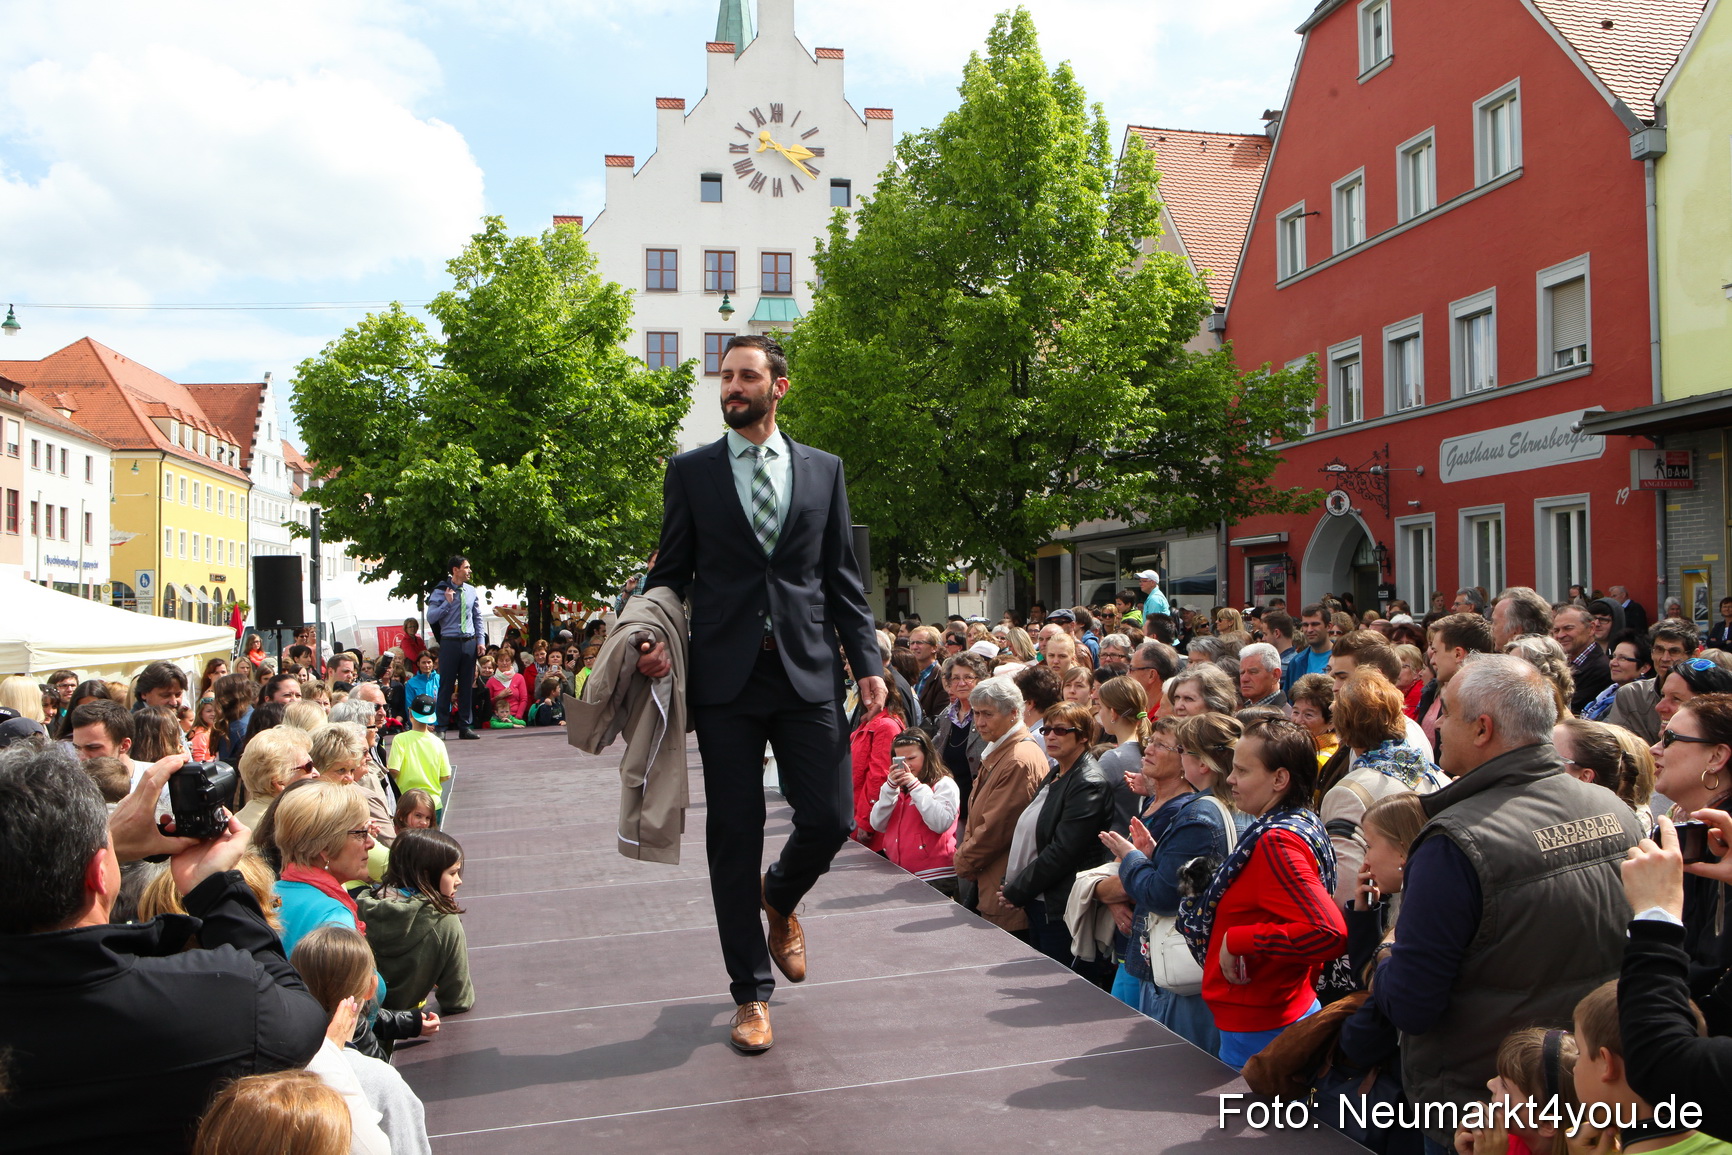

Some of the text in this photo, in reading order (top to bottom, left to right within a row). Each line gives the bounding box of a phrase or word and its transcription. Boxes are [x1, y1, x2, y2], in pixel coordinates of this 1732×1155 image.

[749, 107, 767, 128] XI
[769, 103, 783, 123] XII
[734, 122, 754, 139] X
[801, 127, 819, 140] II
[728, 142, 749, 154] IX
[748, 171, 767, 193] VII
[772, 177, 784, 198] VI
[1446, 426, 1595, 477] Gasthaus Ehrnsberger
[1615, 486, 1630, 505] 19
[1533, 814, 1623, 851] NAPAPIJRI
